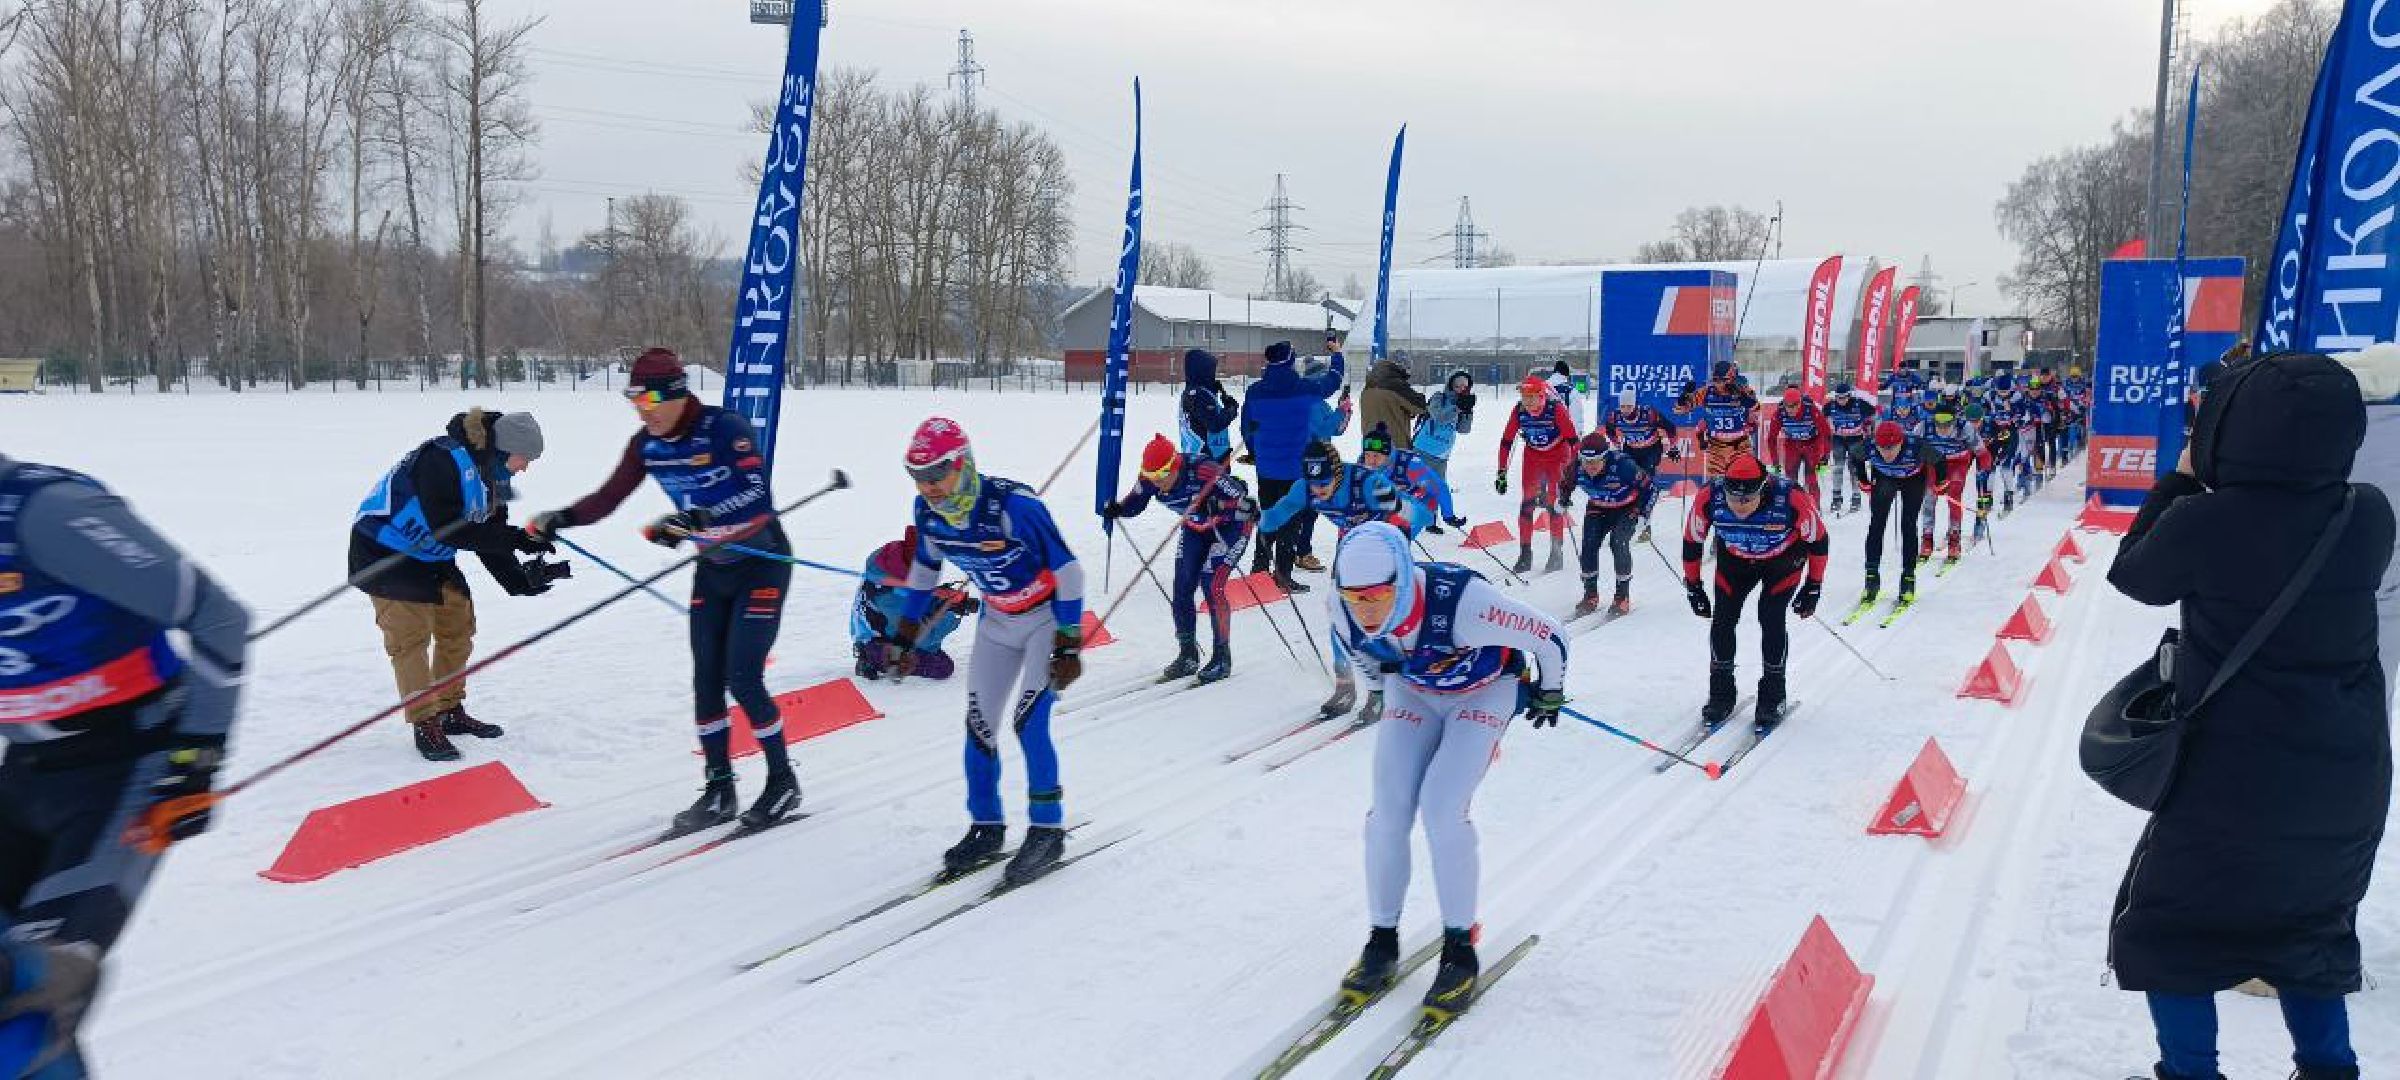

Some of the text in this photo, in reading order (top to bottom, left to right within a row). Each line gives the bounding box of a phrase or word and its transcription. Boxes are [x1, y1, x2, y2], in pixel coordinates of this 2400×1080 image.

[2314, 0, 2400, 350] ИКОЛ
[1610, 364, 1694, 381] RUSSIA
[1714, 417, 1735, 430] 33
